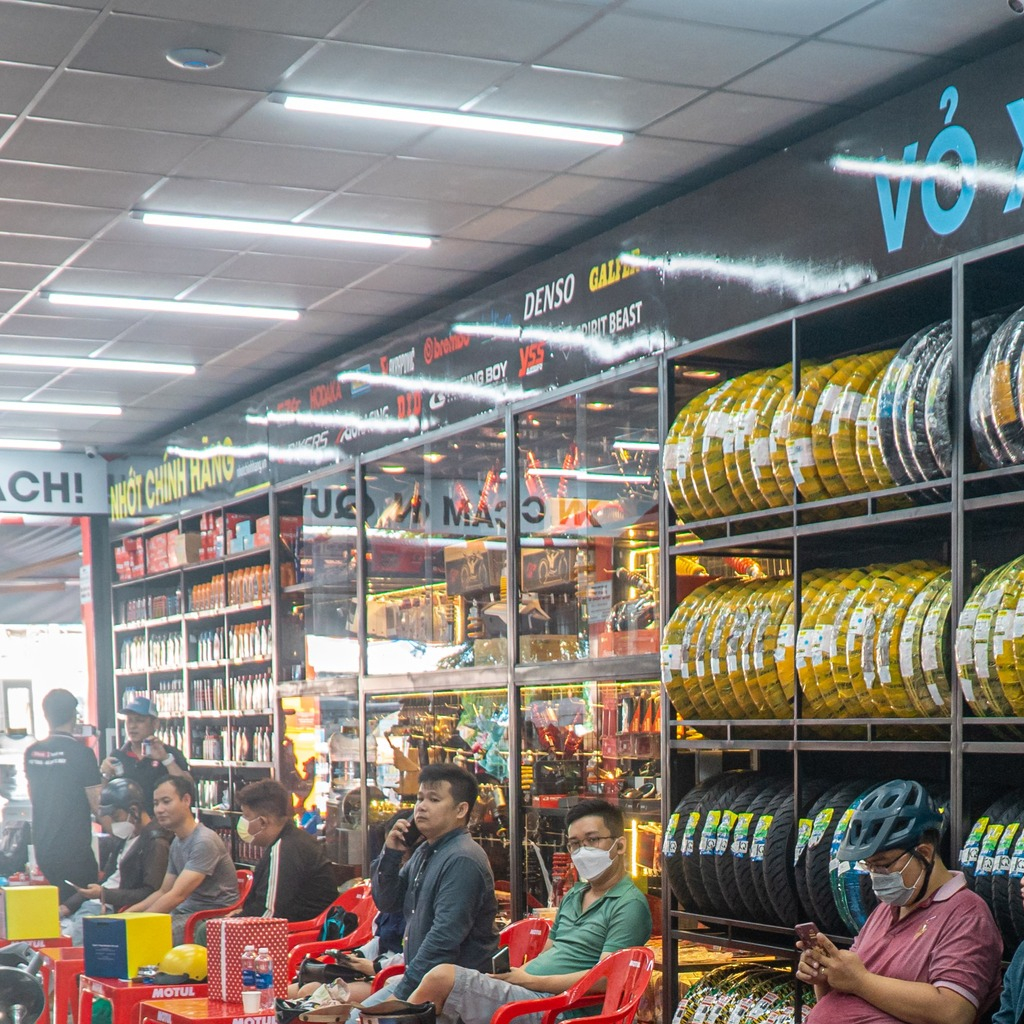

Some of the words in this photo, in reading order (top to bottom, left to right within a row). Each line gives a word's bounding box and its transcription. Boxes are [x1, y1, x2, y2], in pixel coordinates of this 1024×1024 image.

[523, 262, 575, 321] DENSO
[608, 300, 643, 335] BEAST
[485, 360, 508, 385] BOY
[0, 470, 84, 504] CH!
[152, 986, 195, 998] MOTUL
